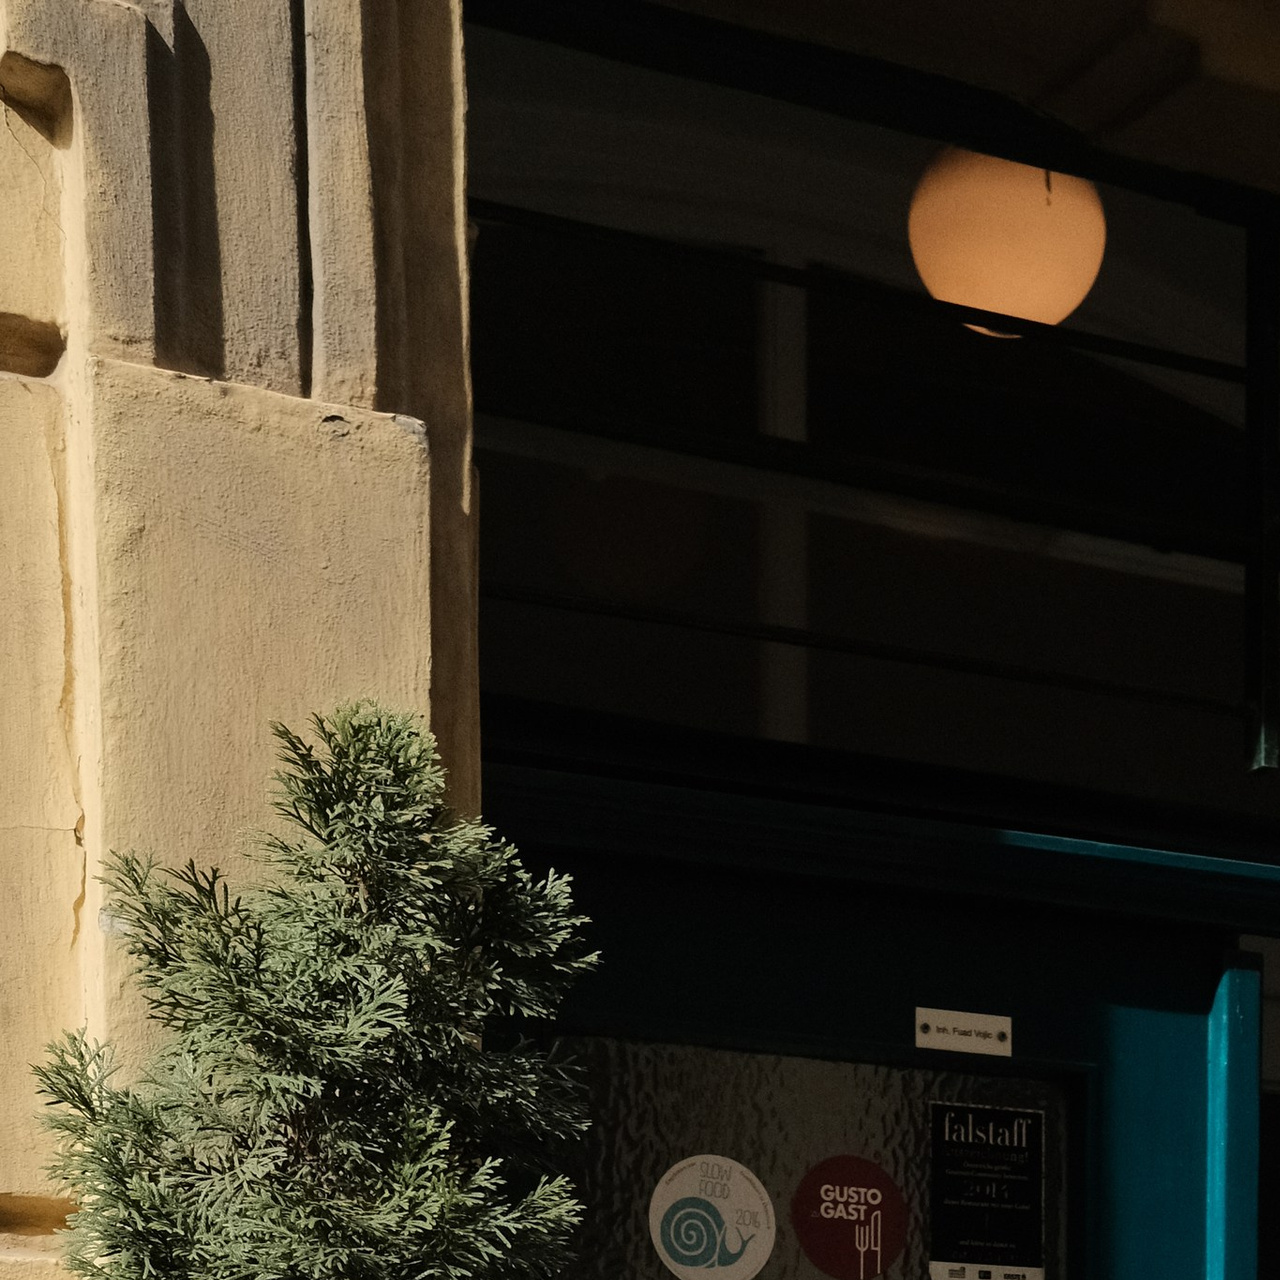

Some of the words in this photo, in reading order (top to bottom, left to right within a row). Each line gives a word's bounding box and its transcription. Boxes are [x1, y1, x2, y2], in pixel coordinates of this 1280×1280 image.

[944, 1111, 1032, 1148] falstaff
[700, 1161, 733, 1182] SLOW
[699, 1178, 731, 1200] FOOD
[820, 1184, 883, 1206] GUSTO
[820, 1201, 868, 1222] GAST
